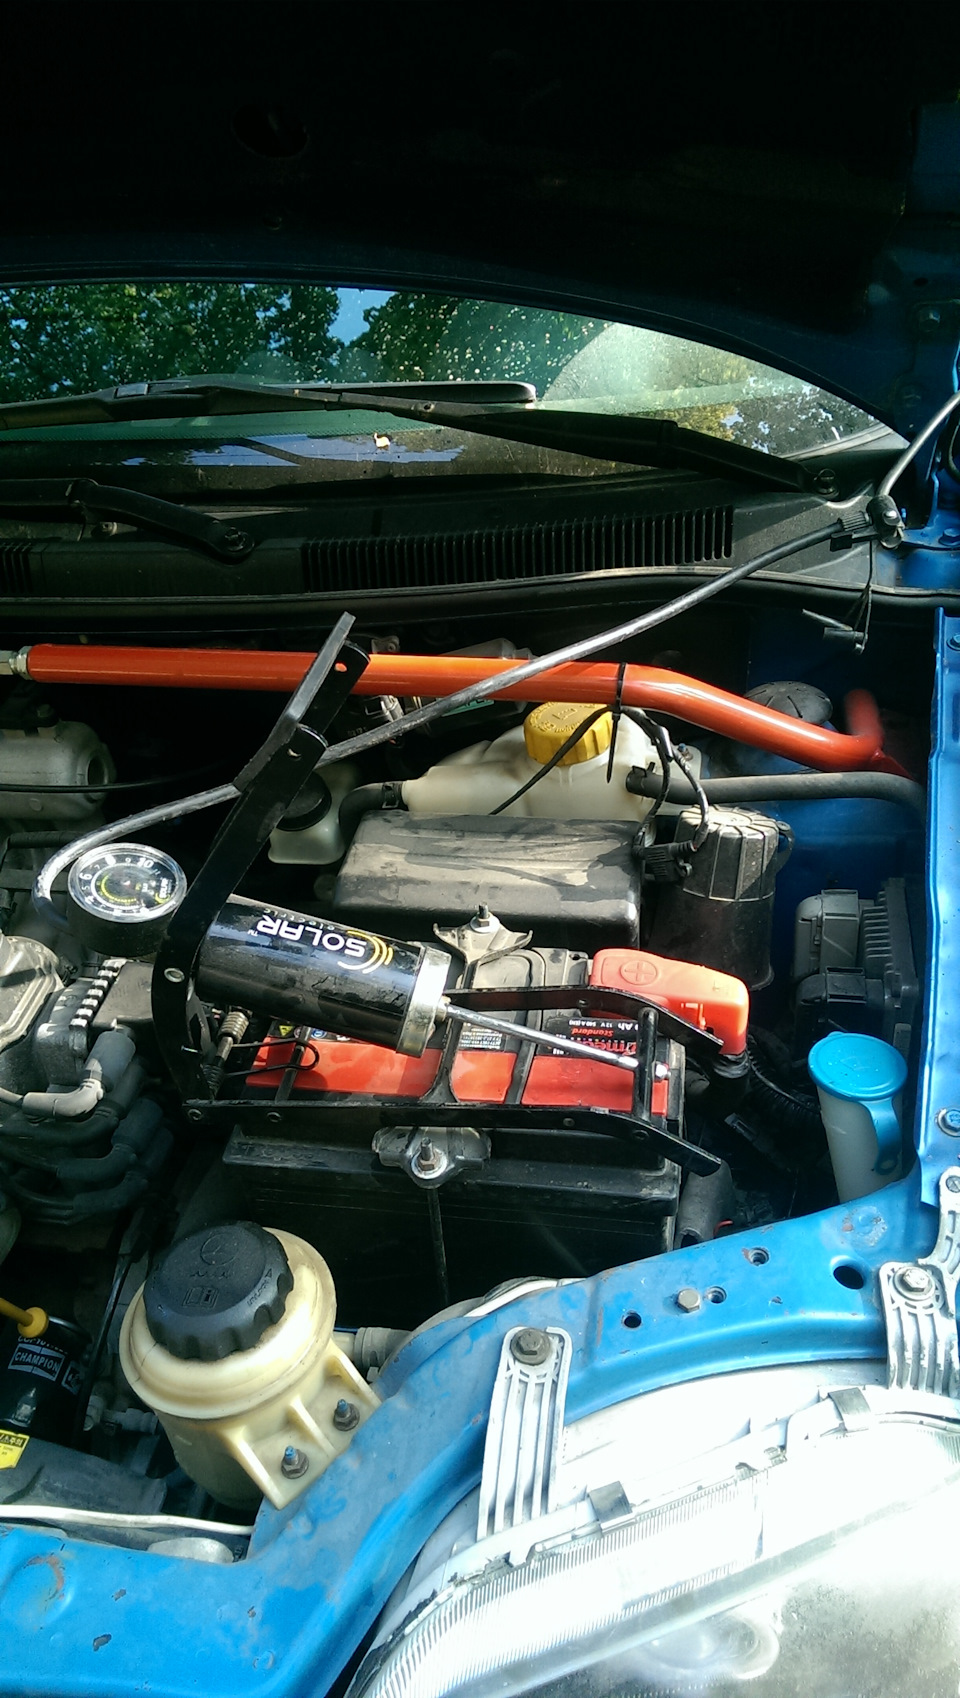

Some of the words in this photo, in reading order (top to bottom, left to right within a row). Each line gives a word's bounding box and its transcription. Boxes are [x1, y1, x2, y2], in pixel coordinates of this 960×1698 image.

[137, 857, 154, 868] 10
[256, 914, 367, 957] SOLAR
[570, 1027, 614, 1037] Standard
[617, 1022, 633, 1031] Ah
[14, 1351, 60, 1371] CHAMPION
